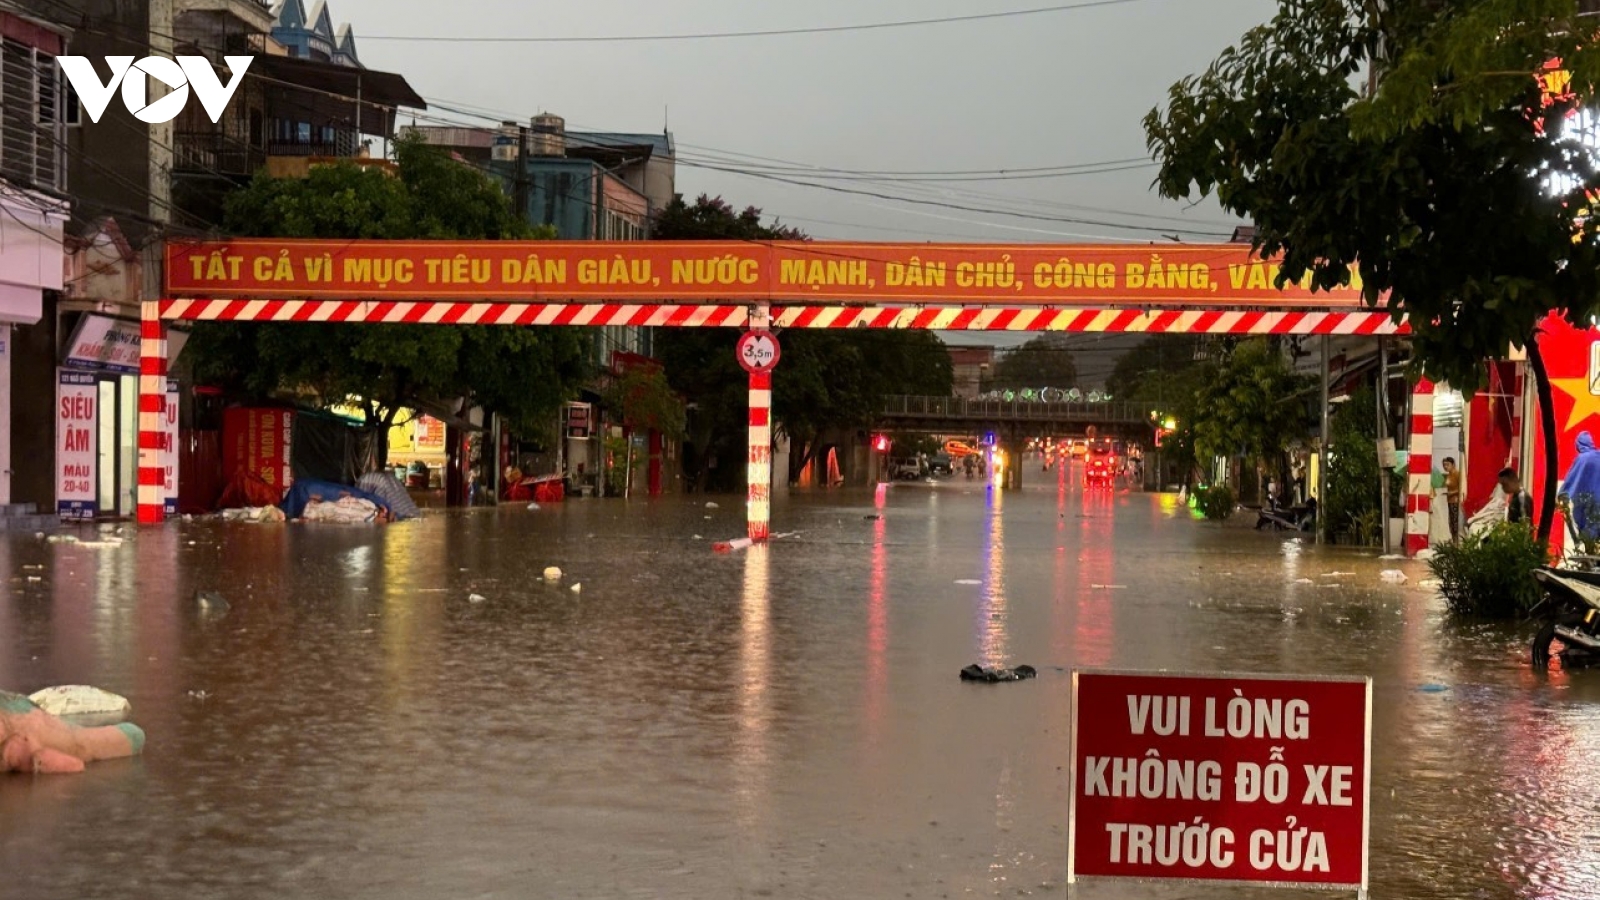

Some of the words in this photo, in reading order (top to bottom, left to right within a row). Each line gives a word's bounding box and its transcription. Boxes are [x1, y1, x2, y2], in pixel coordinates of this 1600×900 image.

[189, 248, 244, 280] TẤT
[253, 249, 294, 281] CẢ
[304, 253, 333, 282] VÌ
[343, 258, 414, 288] MỤC
[424, 254, 491, 284] TIÊU
[502, 254, 566, 284] DÂN
[577, 254, 660, 287] GIÀU,
[671, 254, 759, 284] NƯỚC
[780, 259, 876, 291] MẠNH,
[885, 256, 946, 287] DÂN
[955, 254, 1023, 291] CHỦ,
[1033, 257, 1115, 289] CÔNG
[1125, 254, 1218, 292] BẰNG,
[61, 392, 93, 420] SIÊU
[65, 423, 90, 452] ÂM
[1127, 694, 1191, 736] VUI
[1204, 688, 1310, 740] LÒNG
[1084, 748, 1222, 801] KHÔNG
[1234, 745, 1289, 804] ĐỖ
[1301, 764, 1353, 806] XE
[1105, 815, 1235, 868] TRƯỚC
[1249, 815, 1330, 873] CỬA
